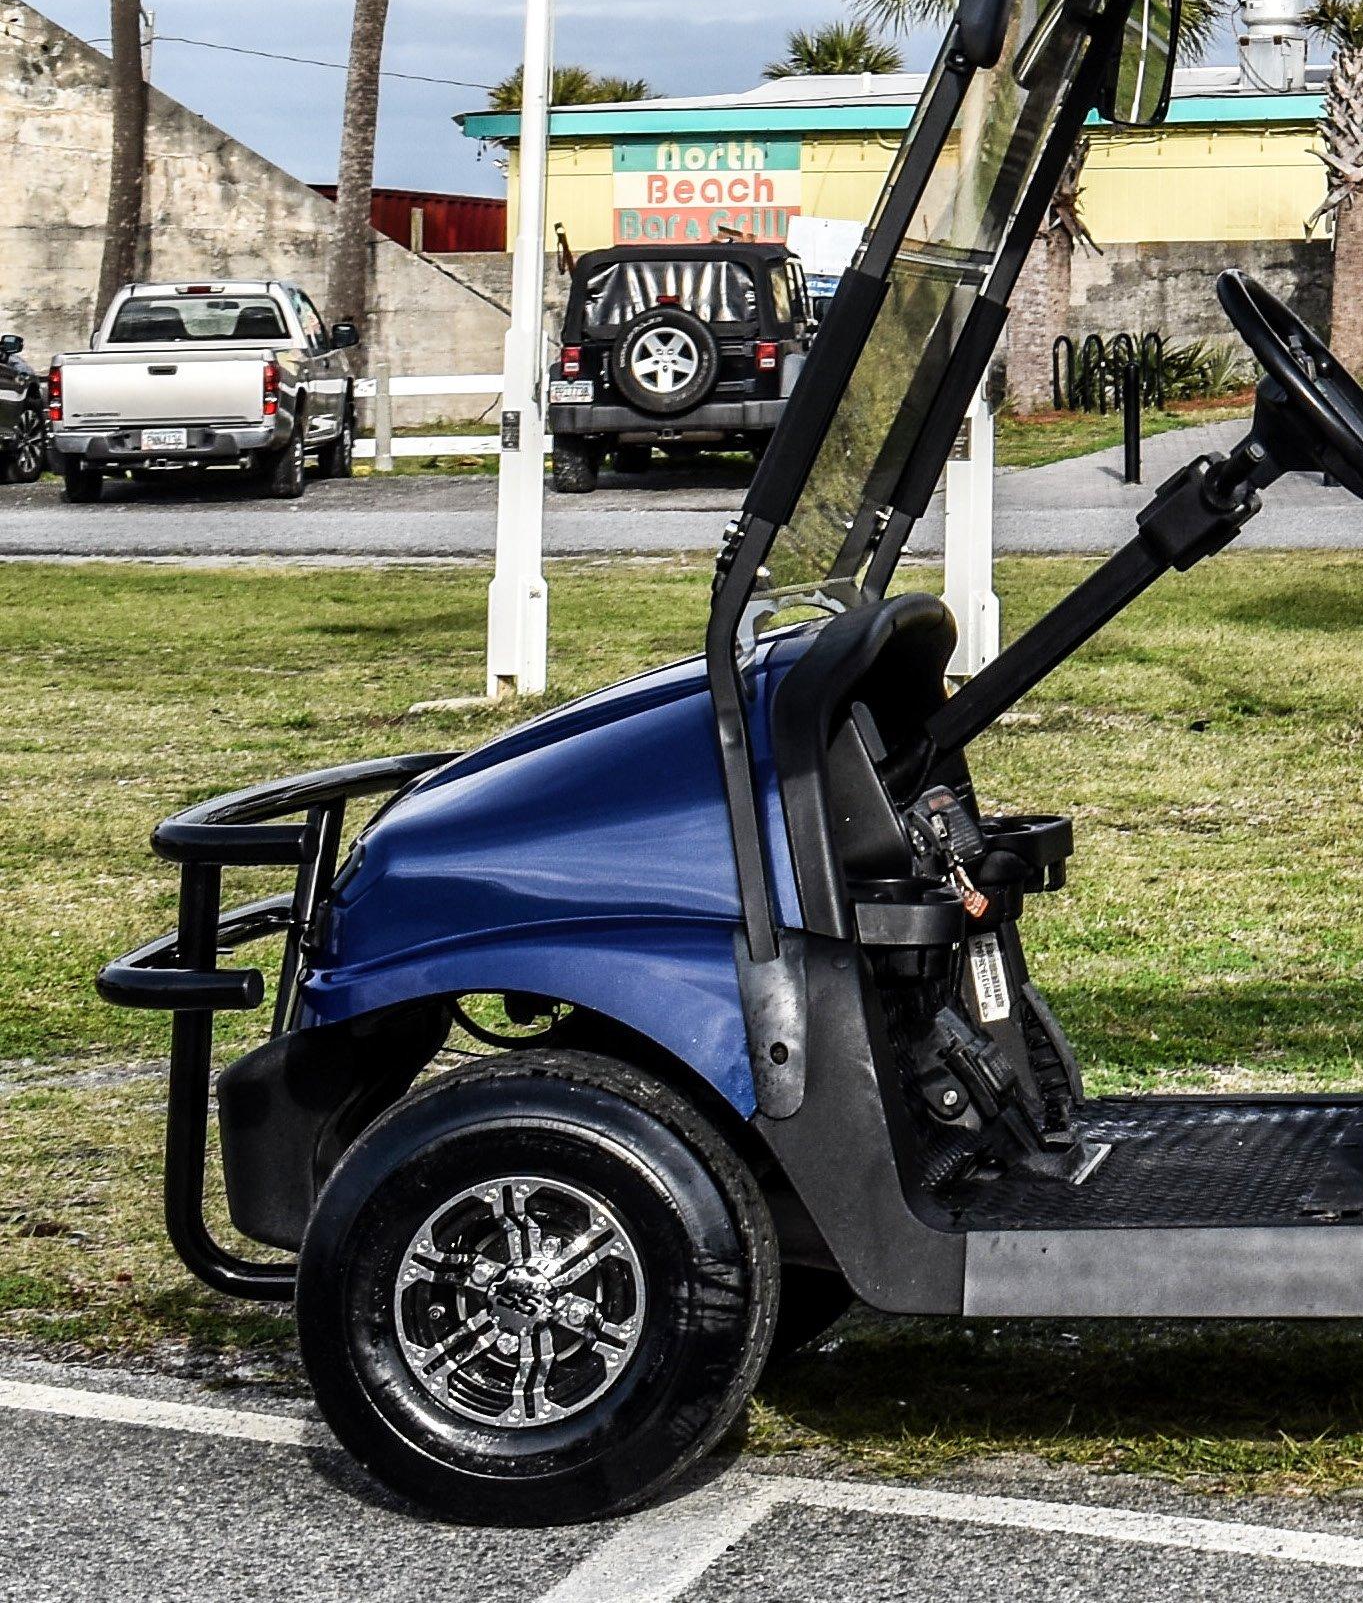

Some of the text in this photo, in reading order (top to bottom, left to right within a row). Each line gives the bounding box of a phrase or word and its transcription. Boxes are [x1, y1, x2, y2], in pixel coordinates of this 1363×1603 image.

[656, 141, 764, 170] North
[647, 173, 774, 204] Beach
[619, 208, 681, 240] Bar
[708, 207, 787, 238] Grill
